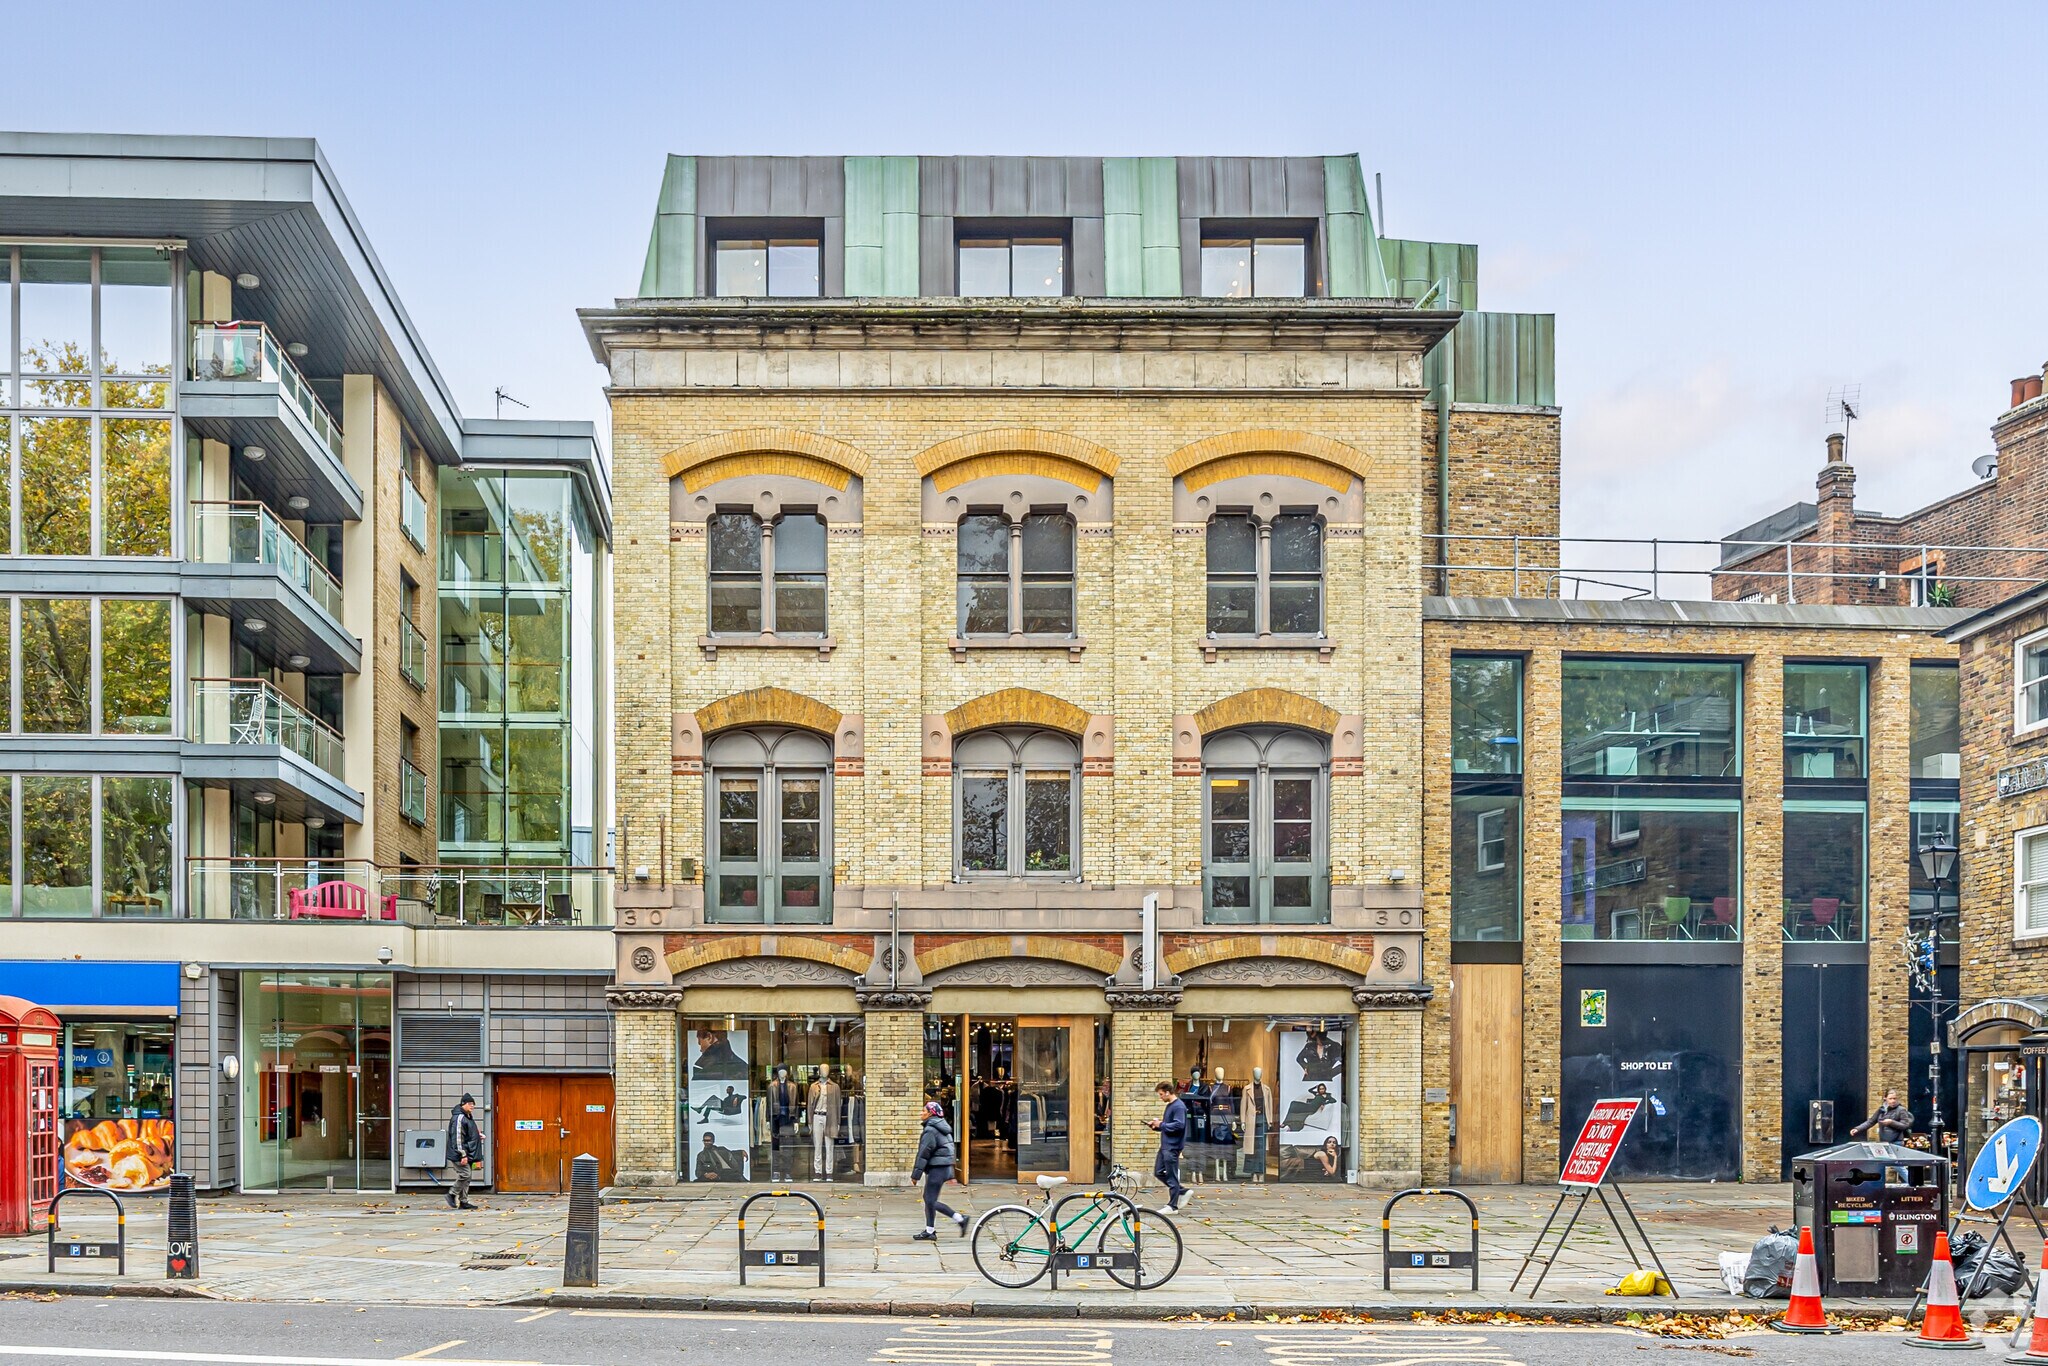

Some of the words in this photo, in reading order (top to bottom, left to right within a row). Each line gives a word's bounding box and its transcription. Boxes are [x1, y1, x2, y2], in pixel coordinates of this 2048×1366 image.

[624, 909, 663, 926] 30
[1375, 910, 1413, 926] 30
[2022, 1046, 2046, 1055] COFFEE
[1620, 1062, 1643, 1070] SHOP
[1644, 1062, 1656, 1070] TO
[1657, 1062, 1673, 1070] LET
[1540, 1085, 1553, 1095] 31
[1590, 1109, 1615, 1120] NARROW
[1612, 1108, 1635, 1120] LANES
[1587, 1125, 1600, 1139] DO
[1598, 1124, 1616, 1139] NOT
[1576, 1142, 1612, 1158] OVERTAKE
[1569, 1160, 1601, 1175] CYCLISTS
[1896, 1213, 1937, 1221] ISLINGTON
[72, 1246, 80, 1255] P
[167, 1242, 192, 1258] LOVE
[767, 1253, 775, 1263] P
[1080, 1257, 1088, 1266] P
[1415, 1255, 1423, 1265] P
